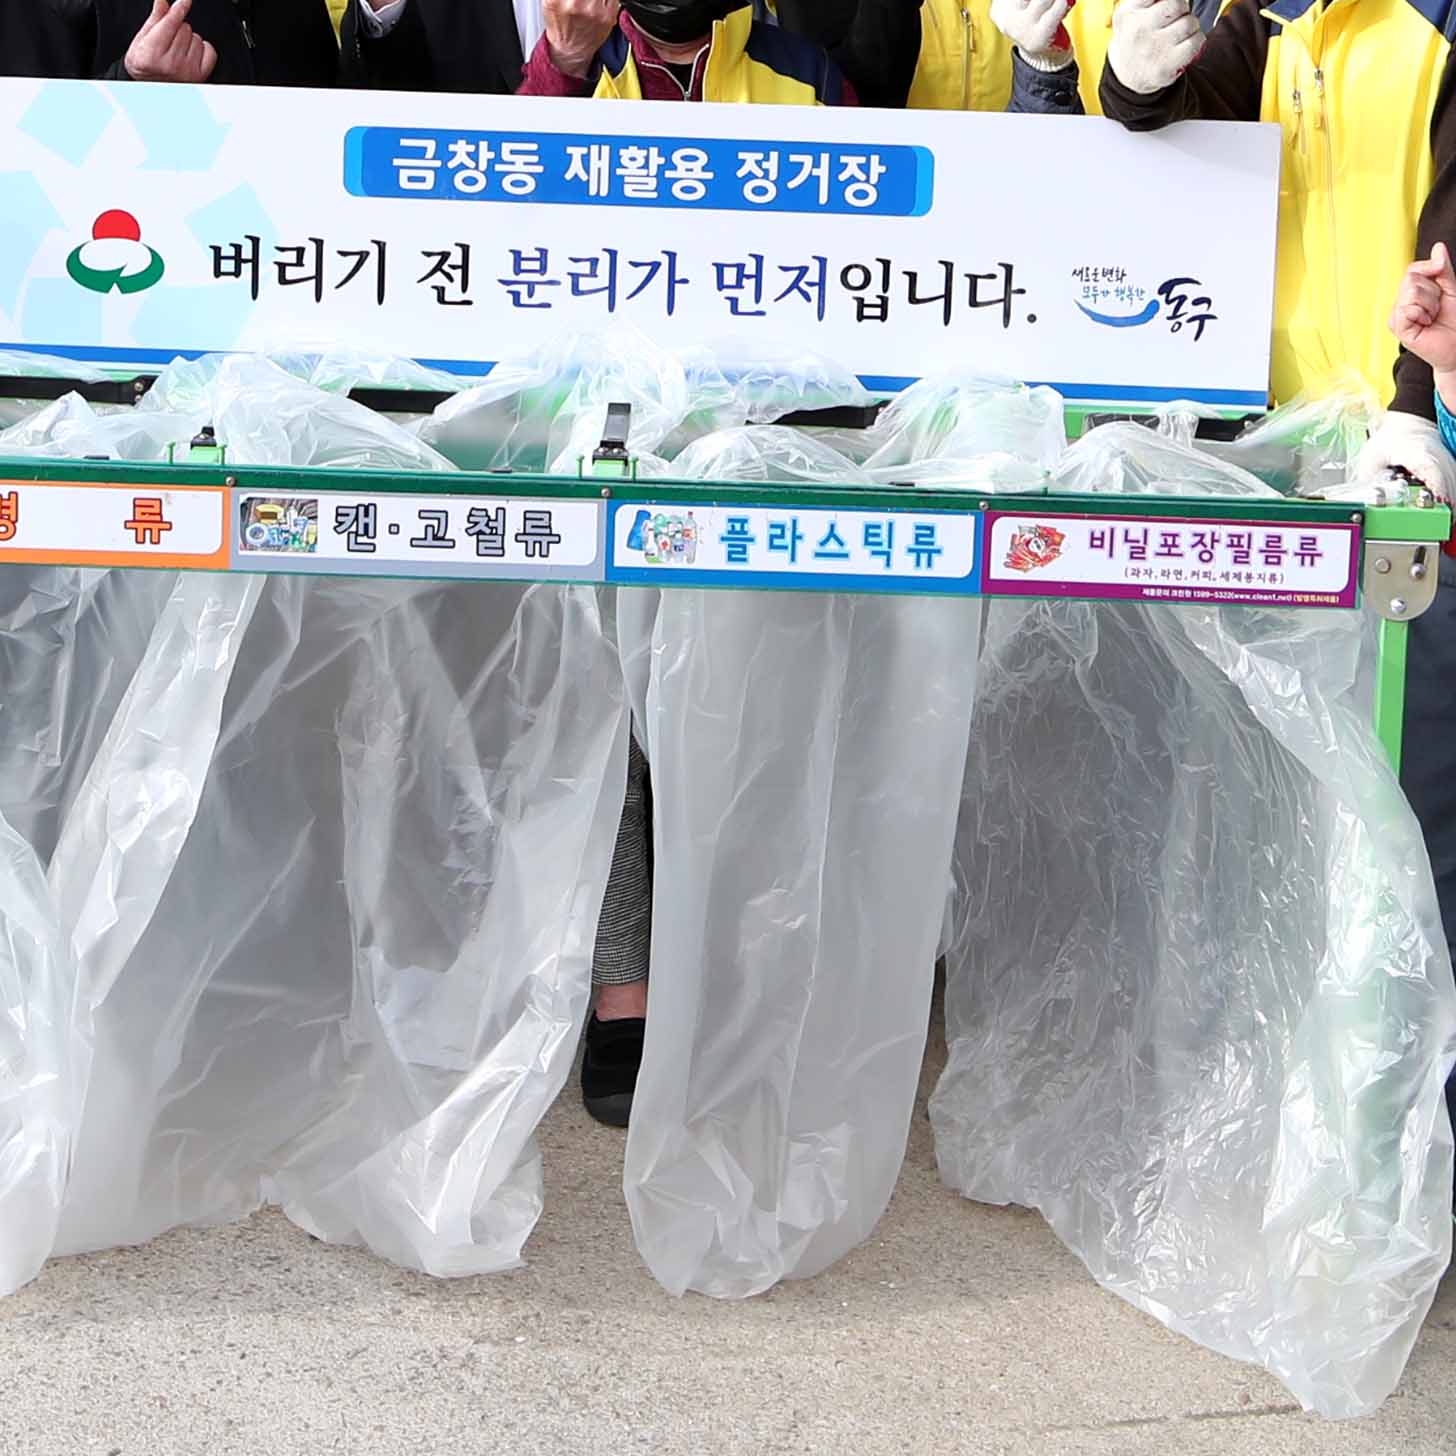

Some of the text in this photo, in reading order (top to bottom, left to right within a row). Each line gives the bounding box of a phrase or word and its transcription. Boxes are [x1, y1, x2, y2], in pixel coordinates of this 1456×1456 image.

[392, 138, 887, 207] 금창동 재활용 정거장
[208, 234, 1038, 329] 버리기 전 분리가 먼저입니다.
[1157, 277, 1219, 342] 동구
[123, 497, 173, 545] 류
[333, 503, 561, 557] 캔·고철류
[719, 515, 945, 570] 플라스틱류
[1088, 527, 1324, 568] 비닐포장필름류
